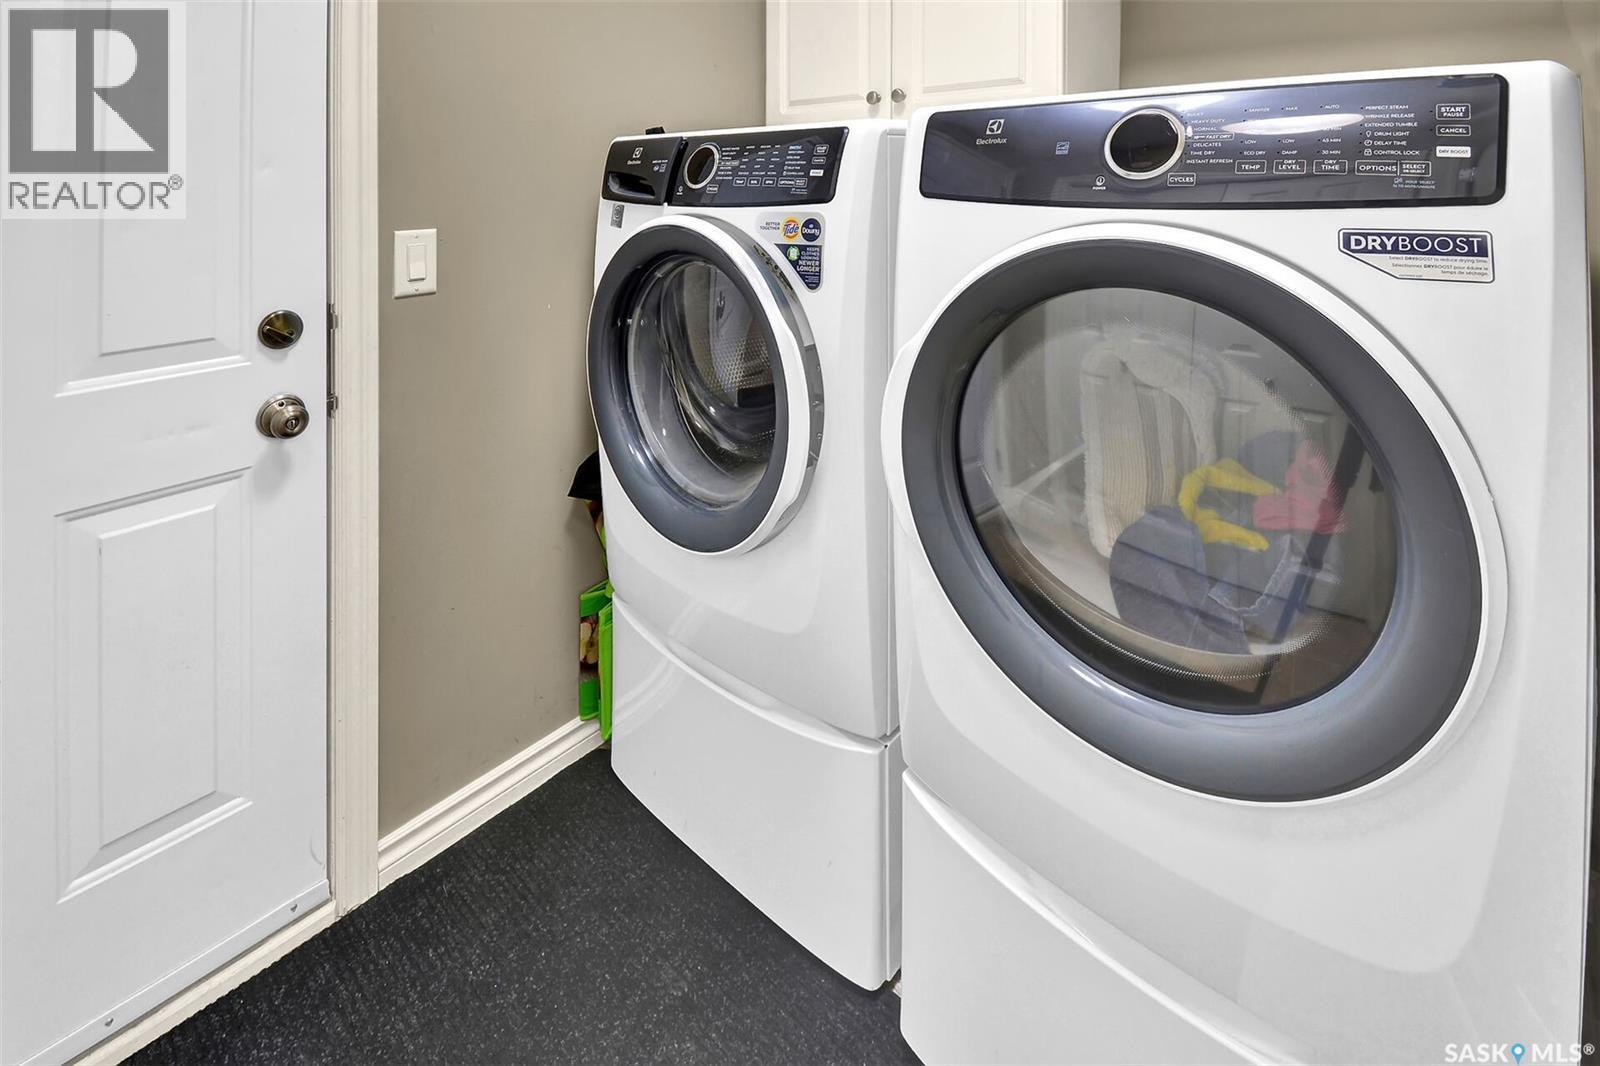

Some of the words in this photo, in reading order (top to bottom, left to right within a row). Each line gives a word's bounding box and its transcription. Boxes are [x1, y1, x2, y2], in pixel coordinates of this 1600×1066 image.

[976, 137, 1007, 146] Electrolux
[784, 223, 800, 236] Tide
[802, 227, 820, 236] Downy
[1350, 235, 1482, 253] DRYBOOST
